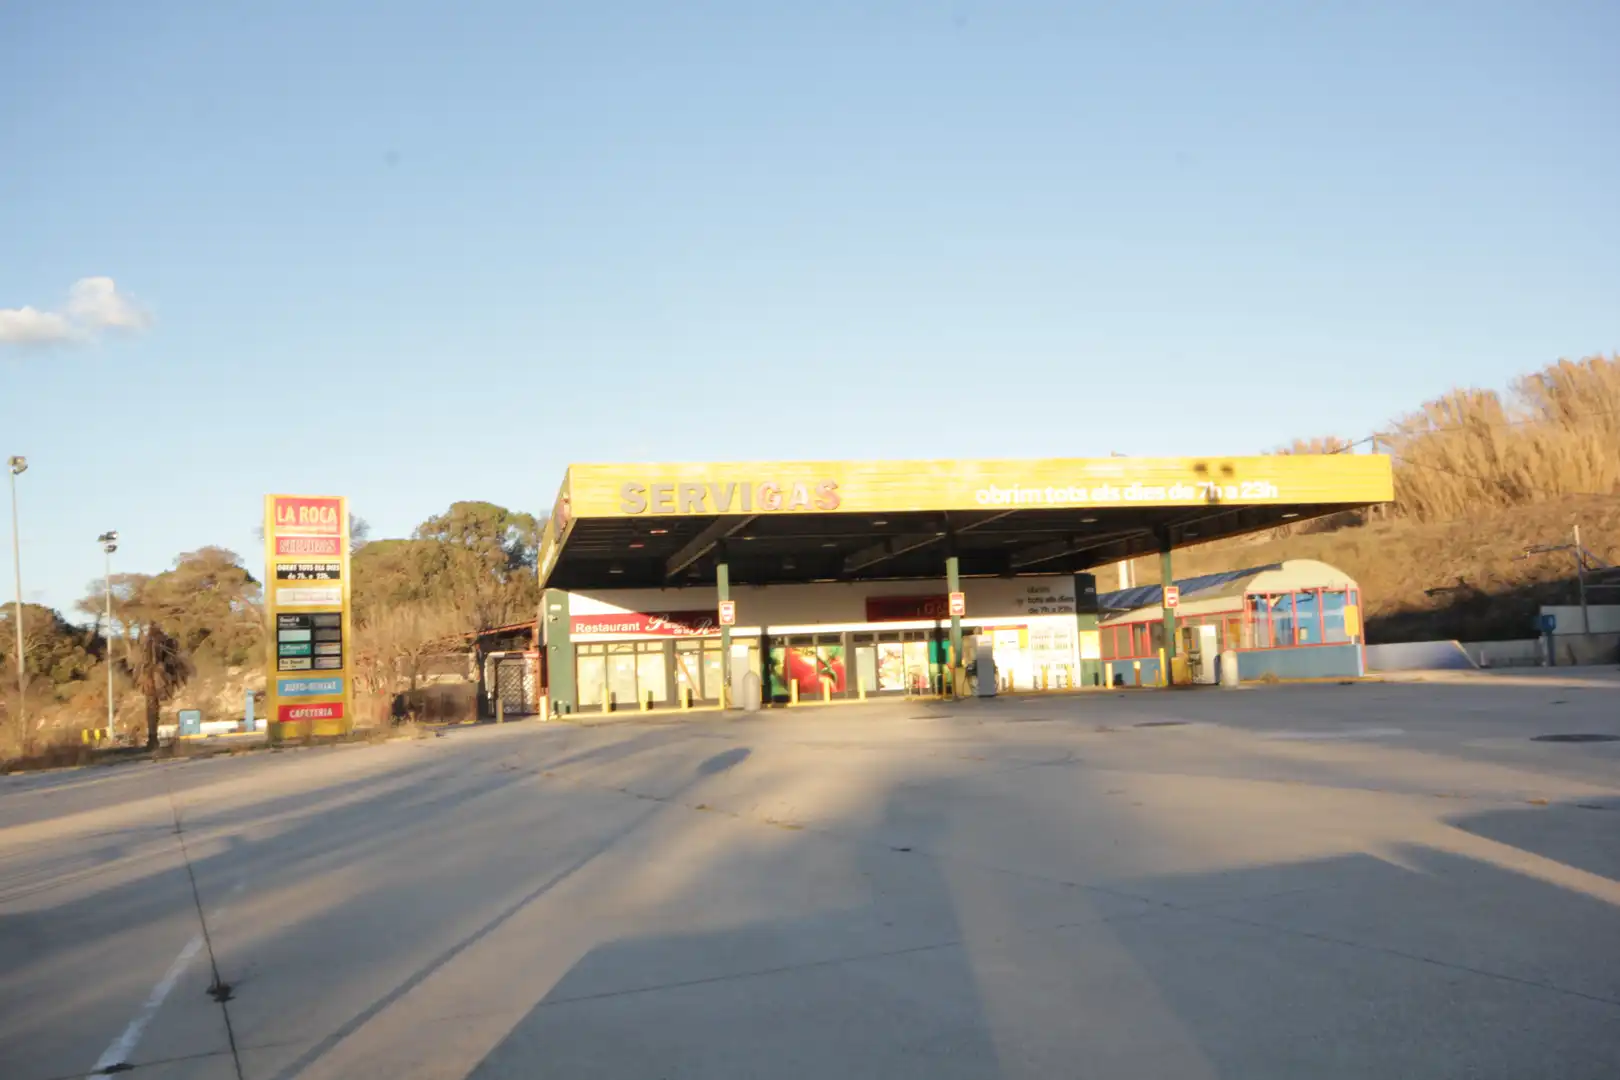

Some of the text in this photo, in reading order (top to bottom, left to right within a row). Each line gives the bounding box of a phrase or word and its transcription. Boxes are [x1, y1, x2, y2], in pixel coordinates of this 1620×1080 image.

[621, 481, 842, 514] SERVIGAS
[976, 483, 1041, 504] obrim
[1044, 485, 1088, 502] tots
[1091, 483, 1121, 501] els
[1124, 482, 1168, 500] dies
[1169, 482, 1195, 499] de
[1225, 486, 1237, 499] a
[1240, 481, 1279, 499] 23h
[277, 504, 338, 524] LA ROCA
[575, 622, 641, 633] Restaurant
[289, 708, 332, 718] CAFETERIA
